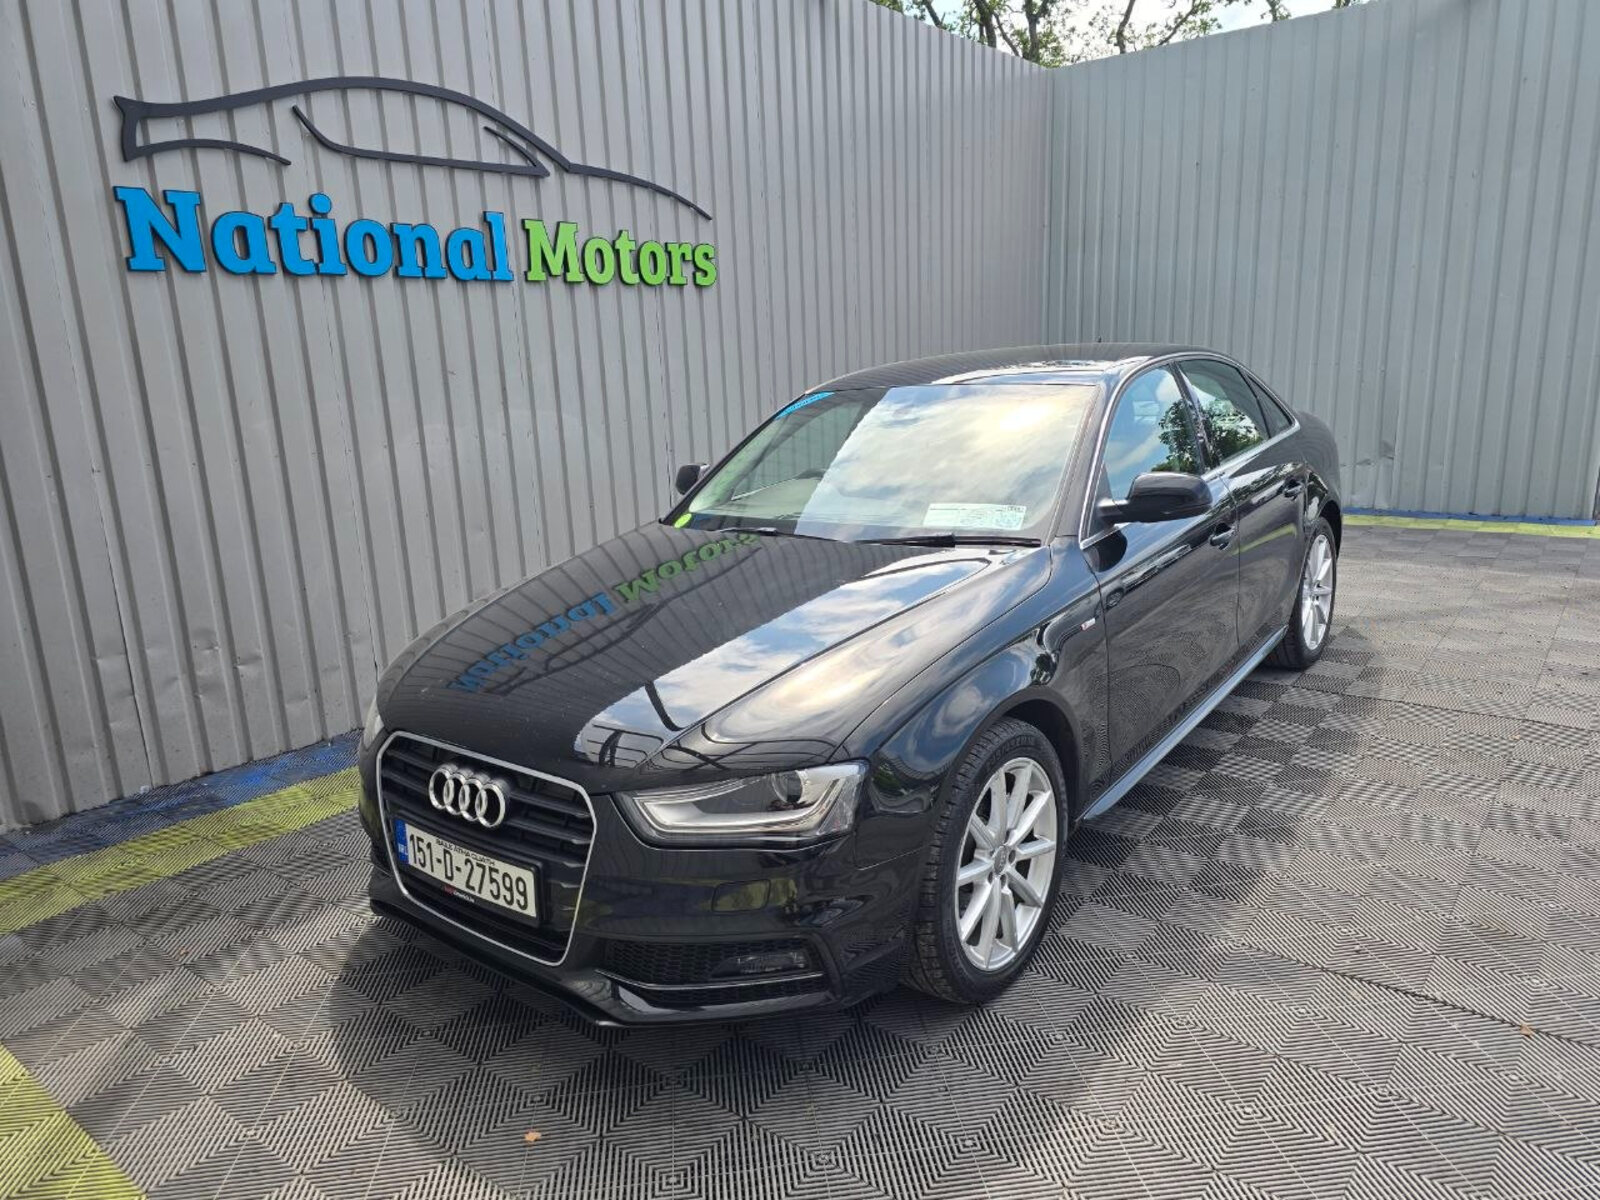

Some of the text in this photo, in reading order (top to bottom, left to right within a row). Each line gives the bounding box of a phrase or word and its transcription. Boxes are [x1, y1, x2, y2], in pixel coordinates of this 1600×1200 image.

[113, 185, 718, 287] National Motors
[409, 833, 529, 911] 151-D-27599
